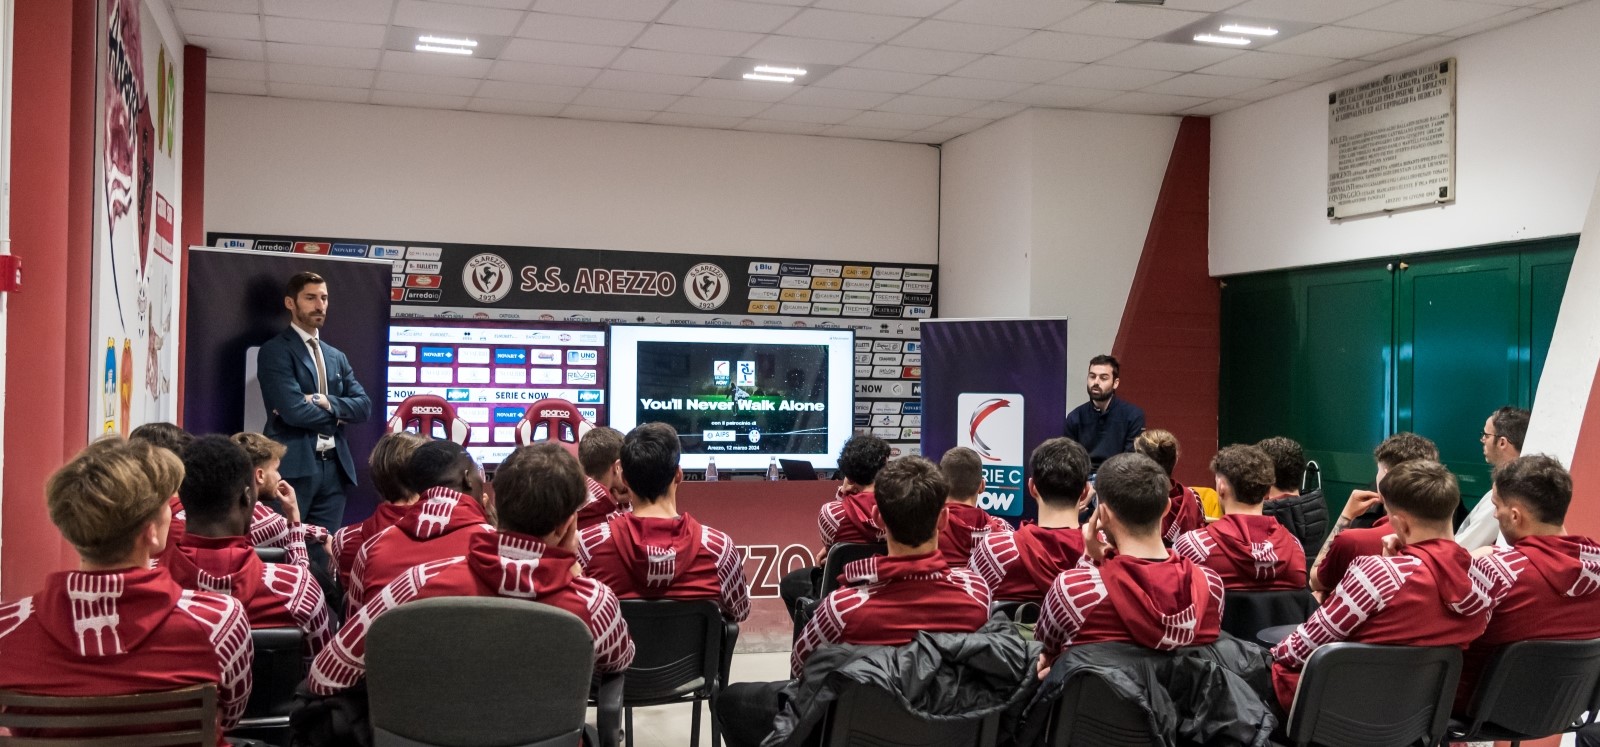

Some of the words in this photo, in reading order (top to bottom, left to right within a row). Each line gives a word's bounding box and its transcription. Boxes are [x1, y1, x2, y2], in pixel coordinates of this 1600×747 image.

[520, 266, 570, 292] S.S.
[573, 268, 676, 297] AREZZO
[861, 384, 882, 393] NOW
[448, 391, 468, 399] NOW
[580, 392, 600, 400] NOW
[640, 398, 682, 410] You'll
[686, 399, 735, 411] Never
[737, 399, 776, 411] Walk
[778, 400, 825, 412] Alone
[412, 406, 443, 414] sparco
[540, 410, 570, 418] sparco
[980, 469, 1004, 483] RIE
[1008, 470, 1021, 484] C
